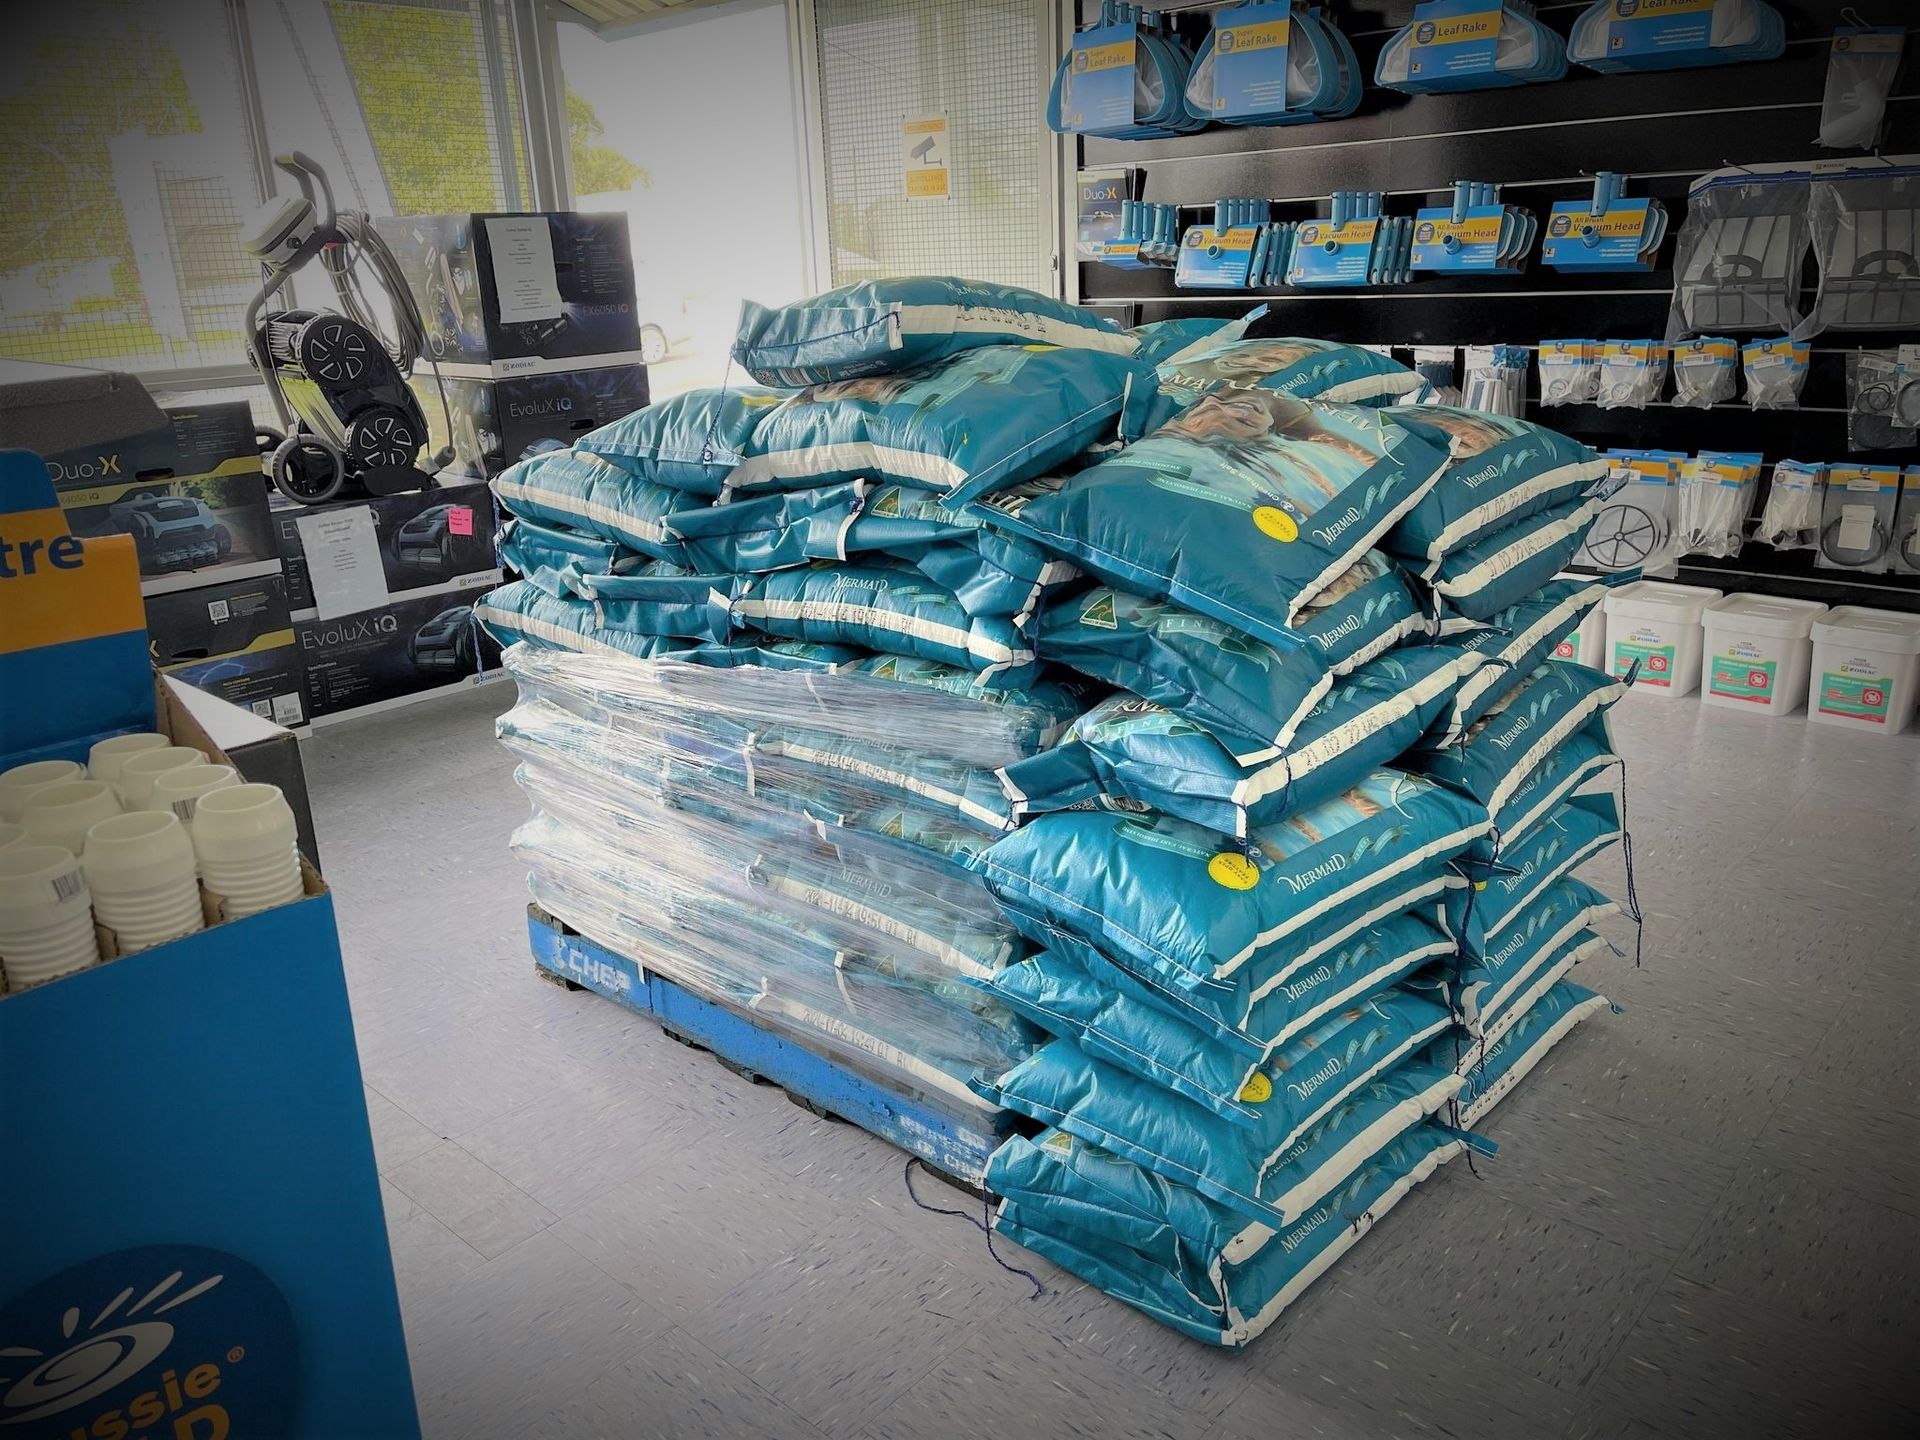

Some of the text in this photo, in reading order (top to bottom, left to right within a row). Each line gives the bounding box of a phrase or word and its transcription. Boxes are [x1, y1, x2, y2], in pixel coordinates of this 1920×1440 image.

[1236, 29, 1254, 37] Super
[1236, 34, 1277, 48] Leaf Rake
[1438, 22, 1487, 37] Leaf Rake
[1090, 54, 1126, 67] Leaf Rake
[1083, 187, 1117, 200] Duo-X
[1203, 235, 1252, 246] Vacuum Head
[1319, 229, 1373, 241] Vacuum Head
[1436, 228, 1498, 239] Vauum Head
[1573, 221, 1641, 234] Vauum Head
[1277, 372, 1309, 393] ERMAID
[510, 397, 573, 418] EvoluX iQ
[1220, 461, 1281, 501] Cheetham Salt
[1313, 506, 1360, 545] MERMAID
[832, 571, 889, 592] MERMAID
[302, 614, 398, 650] EvoluX iQ
[1309, 614, 1360, 651] MERMAID
[1490, 716, 1529, 751] MERMAID
[837, 866, 893, 899] MERMAID
[1278, 853, 1346, 895] MERMAID
[1497, 860, 1534, 895] MERMAID
[1485, 932, 1525, 970] MERMAID
[1278, 963, 1332, 1003] MERMAID
[1287, 1057, 1342, 1101] MERMAID
[1280, 1207, 1329, 1255] MERMAID
